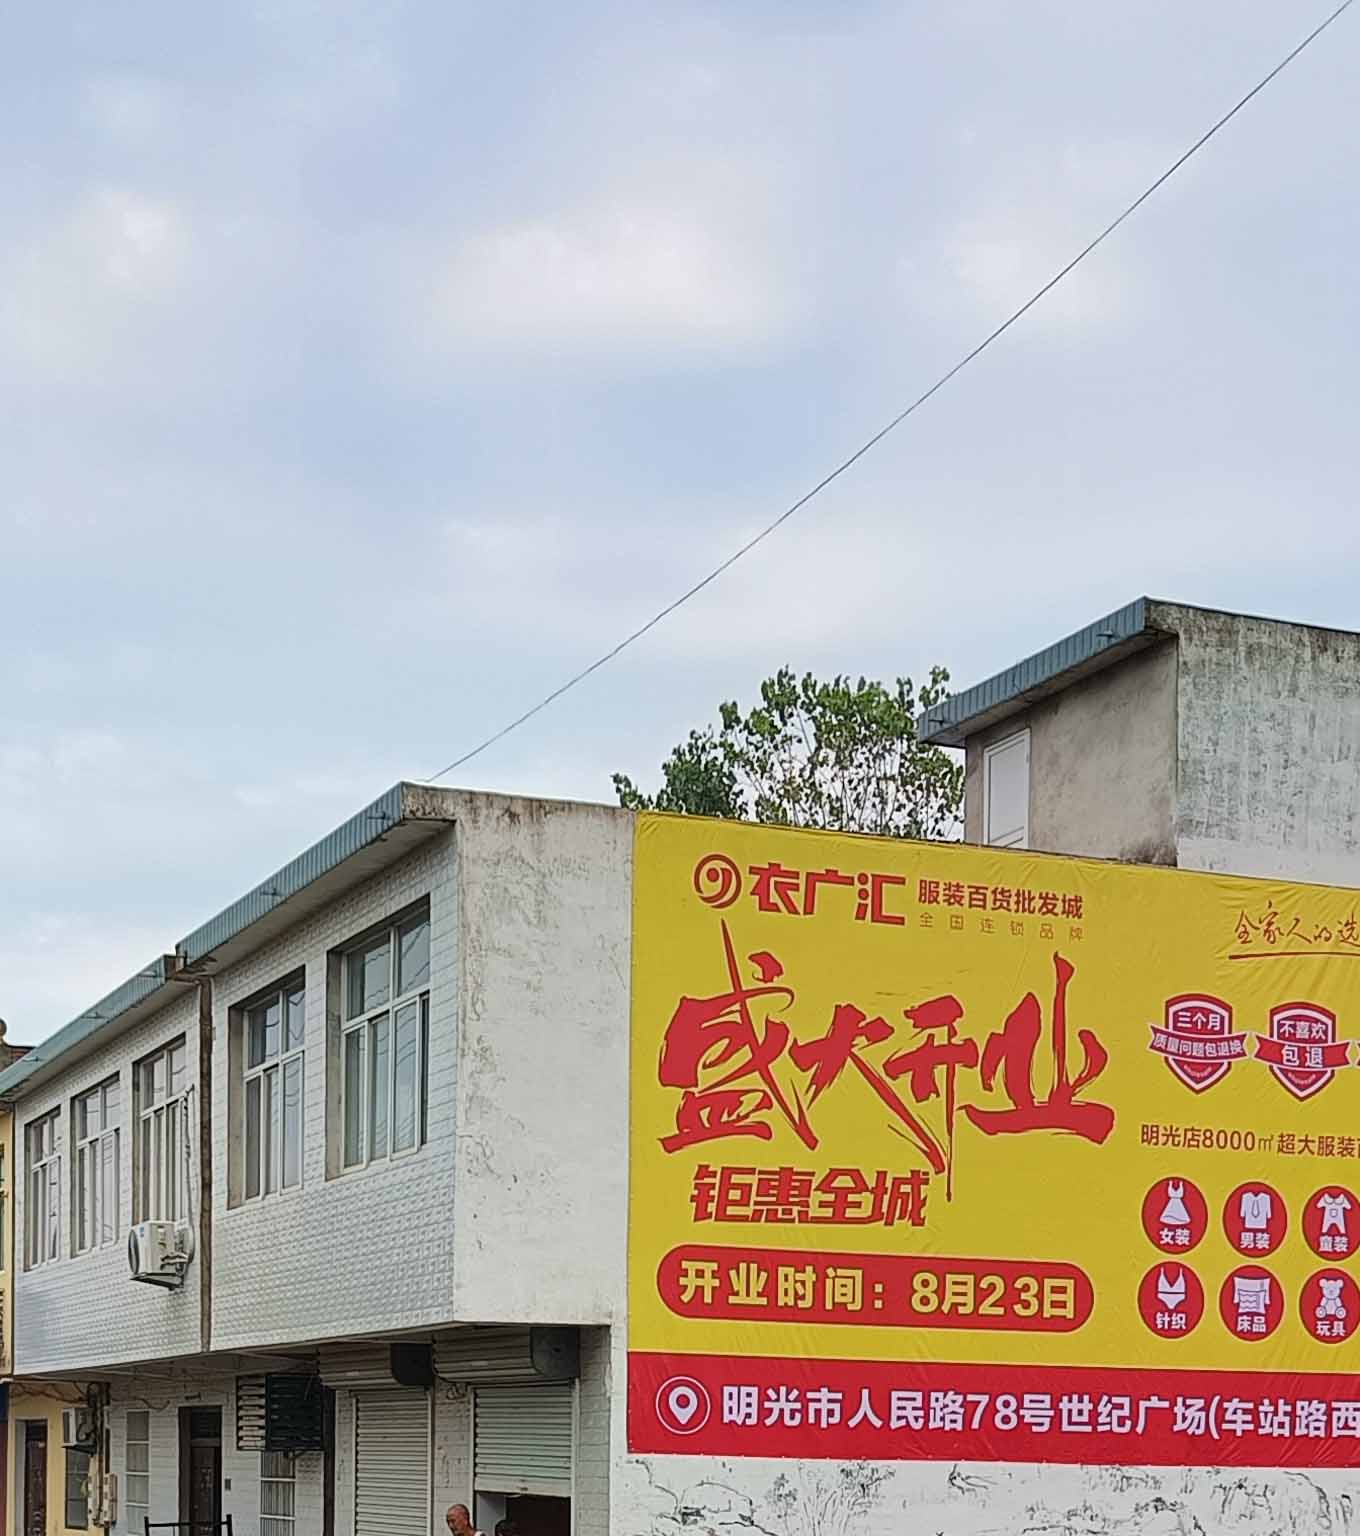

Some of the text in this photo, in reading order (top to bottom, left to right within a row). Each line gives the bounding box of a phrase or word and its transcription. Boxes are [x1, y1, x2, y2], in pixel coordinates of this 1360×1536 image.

[748, 862, 906, 926] 衣广汇
[918, 880, 1084, 920] 服装百货批发城
[919, 912, 1085, 941] 全国连锁品牌
[1177, 1011, 1221, 1031] 三个月
[1279, 1020, 1326, 1040] 不喜欢
[658, 917, 1116, 1203] 盛大开业
[1281, 1045, 1325, 1068] 包退
[690, 1163, 930, 1227] 钜惠全城
[1159, 1228, 1191, 1247] 女装
[1240, 1232, 1271, 1250] 男装
[1319, 1235, 1349, 1253] 童装
[1155, 1312, 1187, 1330] 针织
[1236, 1315, 1267, 1333] 床品
[1316, 1320, 1346, 1337] 玩具
